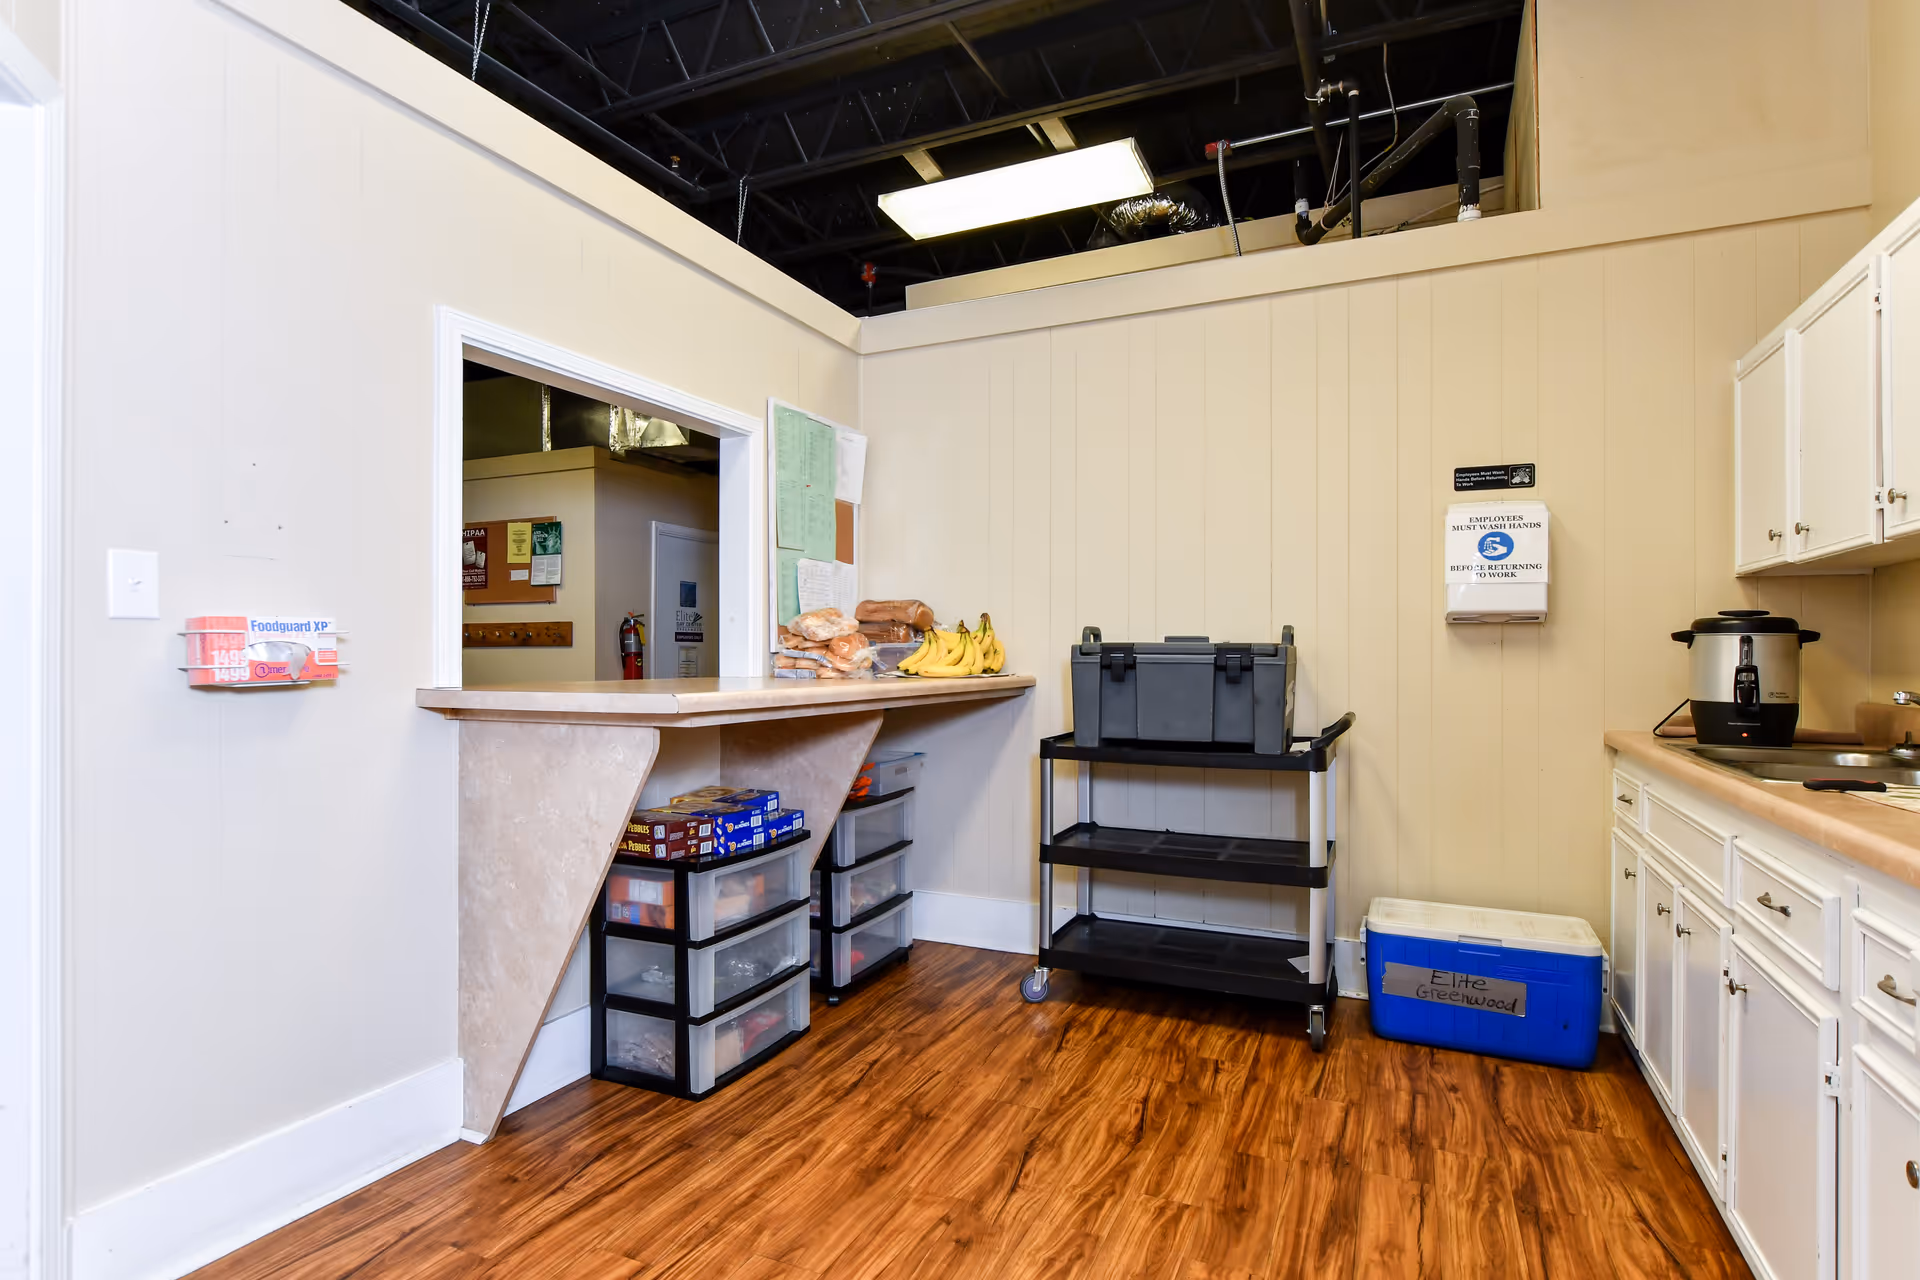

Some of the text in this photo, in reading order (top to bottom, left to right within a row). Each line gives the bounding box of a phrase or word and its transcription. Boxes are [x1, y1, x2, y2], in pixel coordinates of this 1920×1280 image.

[1469, 515, 1524, 523] EMPLOYEES
[1487, 563, 1542, 571] RETURNING
[676, 610, 694, 622] Elite
[250, 620, 311, 633] Foodguard
[627, 822, 650, 834] PEBBLES
[628, 840, 651, 853] PEBBLES
[1430, 969, 1489, 991] Elite
[1416, 984, 1518, 1013] Greenwood
